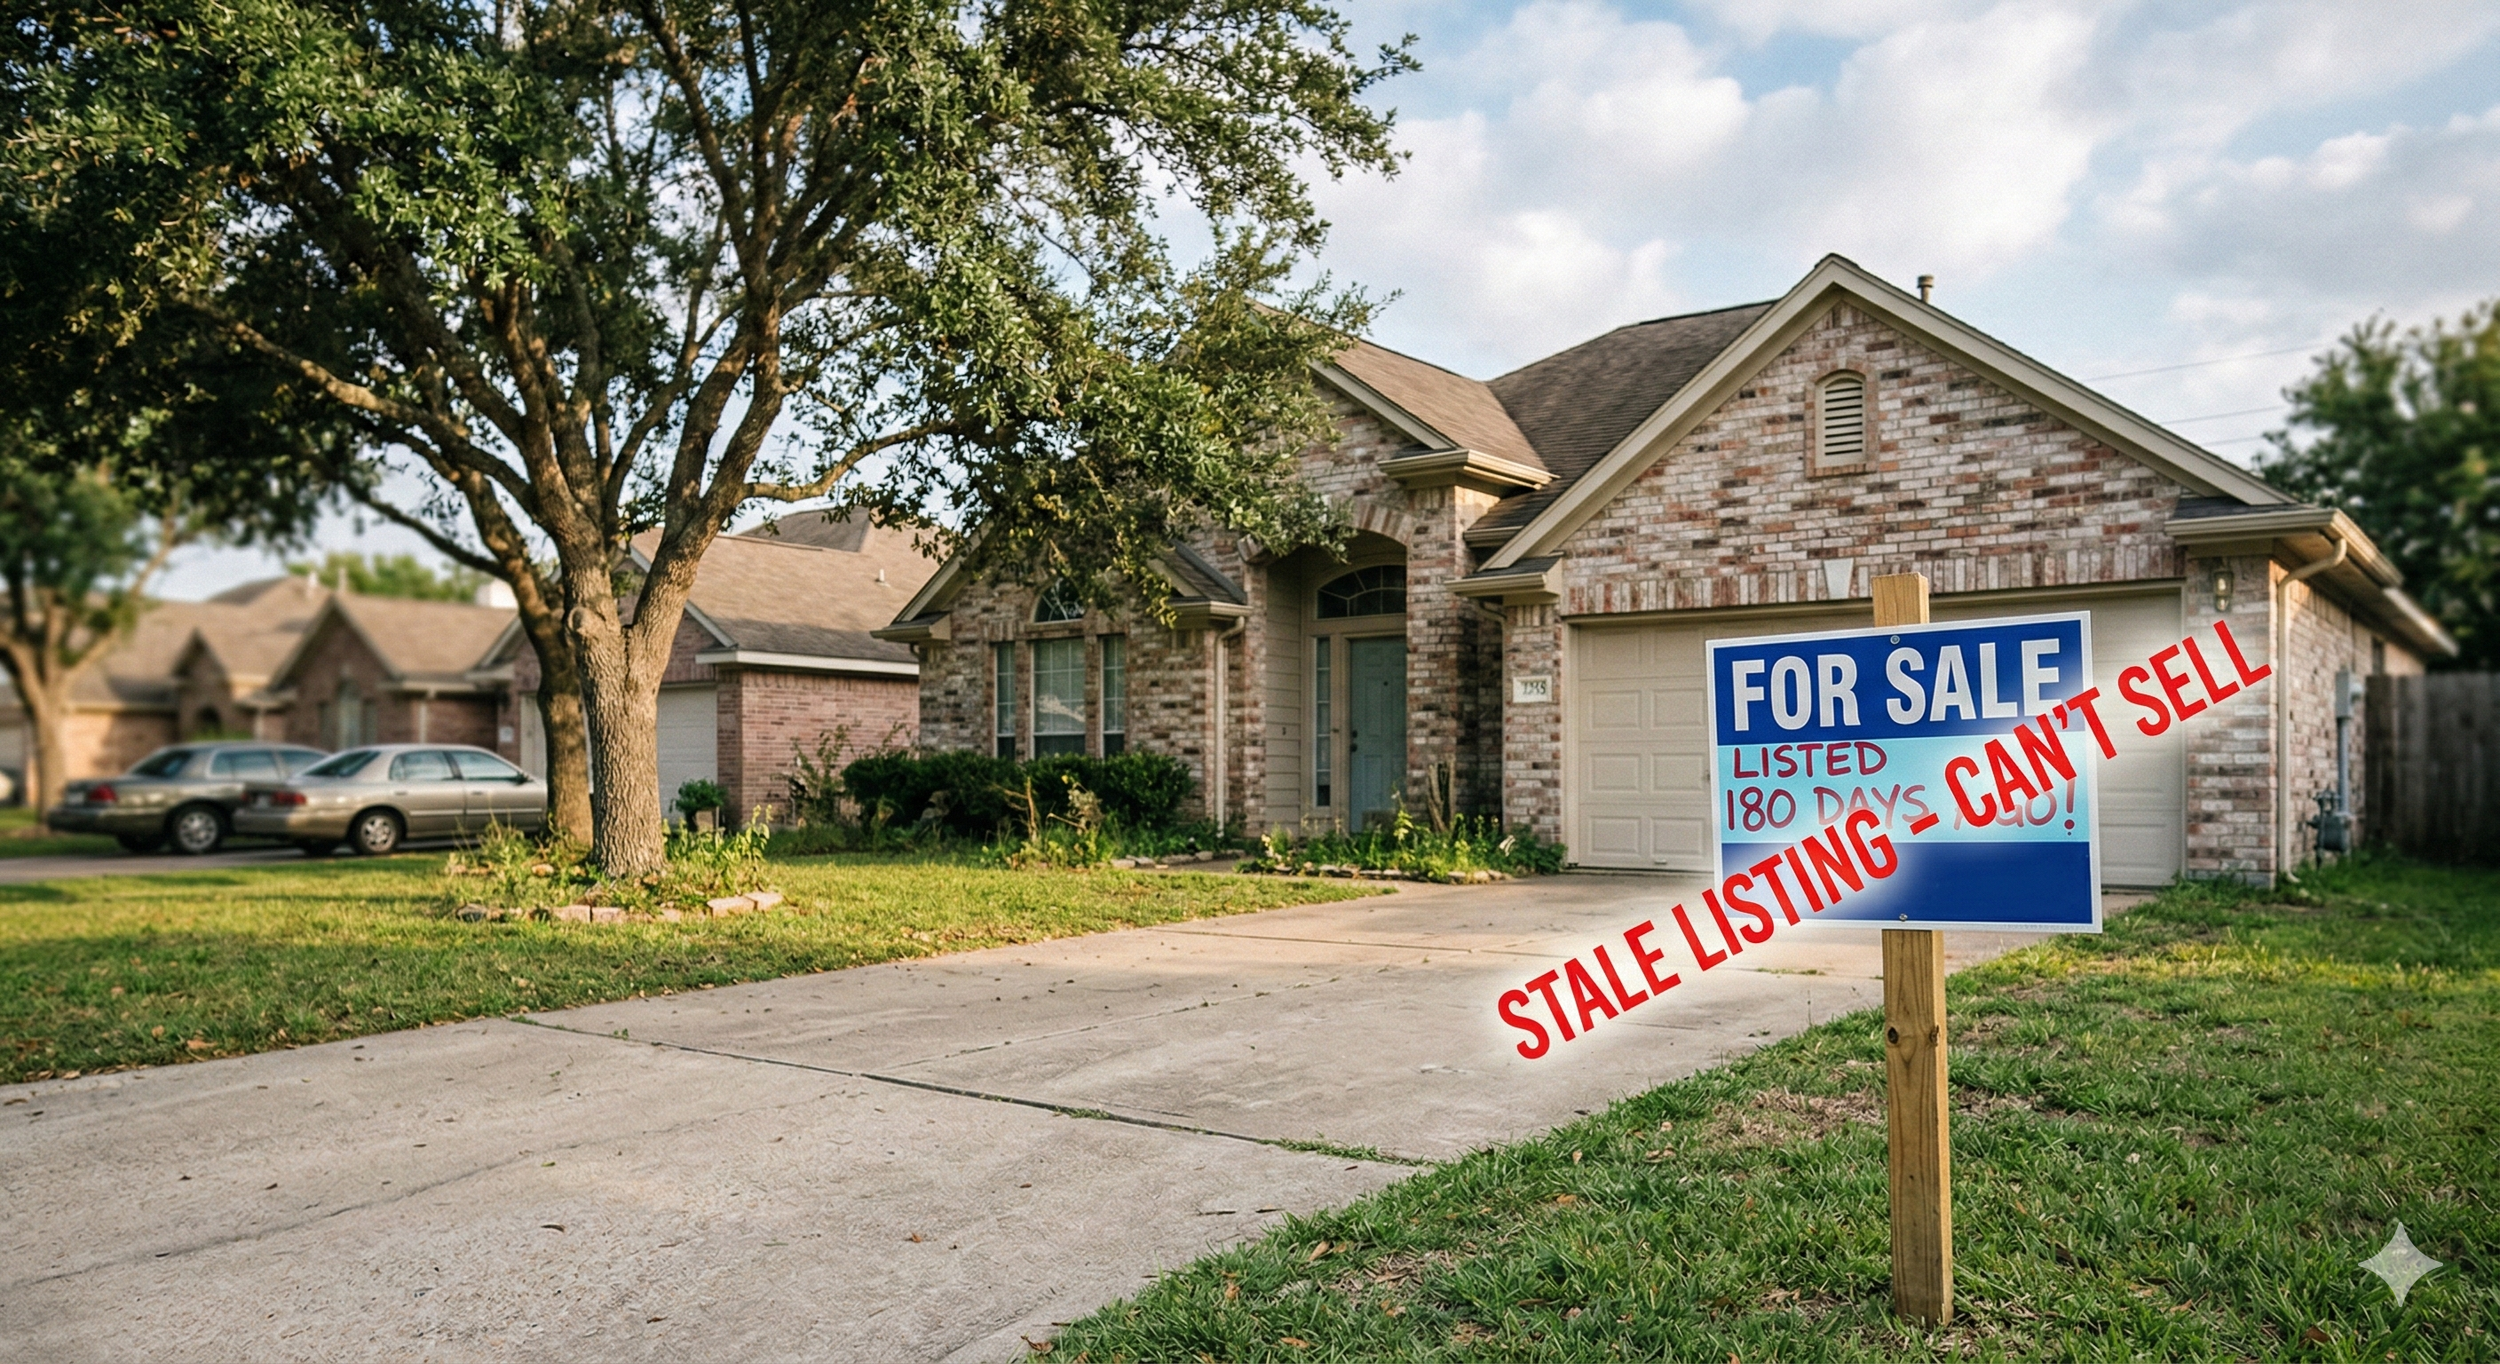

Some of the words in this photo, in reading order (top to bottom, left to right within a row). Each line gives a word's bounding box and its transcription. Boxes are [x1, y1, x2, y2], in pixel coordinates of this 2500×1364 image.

[1731, 654, 1862, 732] FOR
[1885, 637, 2063, 725] SALE
[1733, 741, 1888, 779] LISTED
[1726, 786, 1797, 832] 180
[1812, 784, 1931, 831] DAYS
